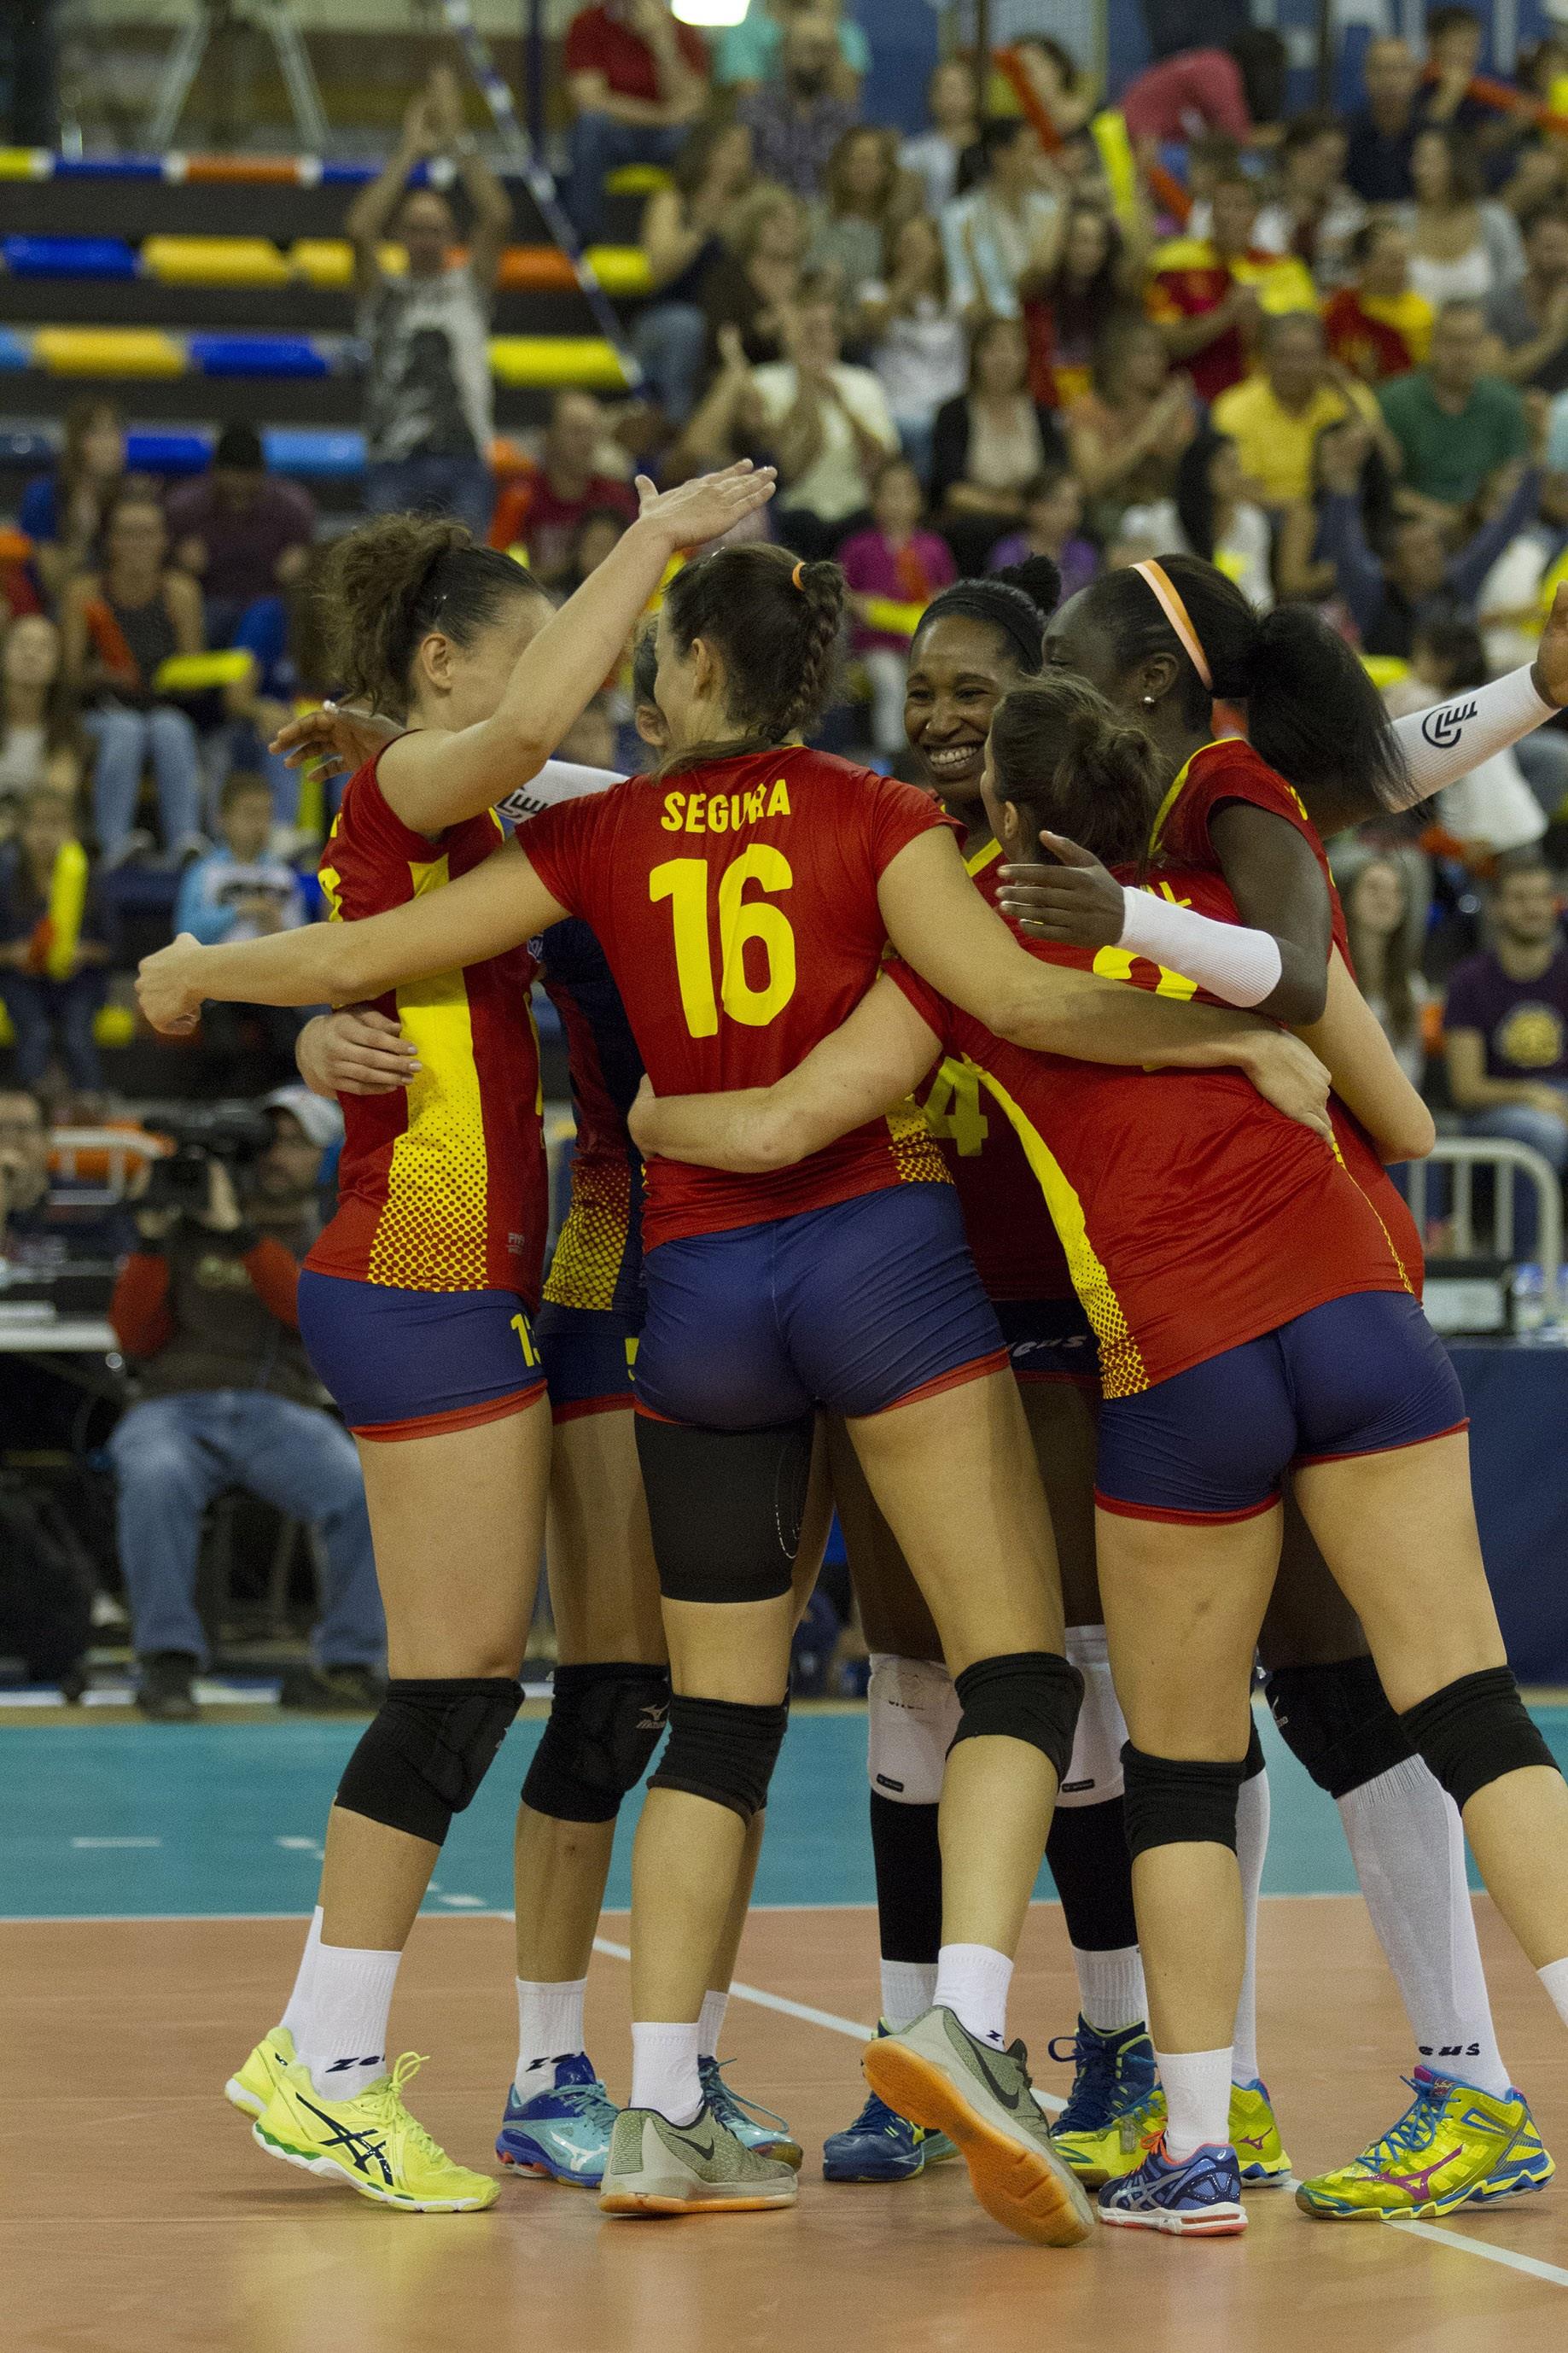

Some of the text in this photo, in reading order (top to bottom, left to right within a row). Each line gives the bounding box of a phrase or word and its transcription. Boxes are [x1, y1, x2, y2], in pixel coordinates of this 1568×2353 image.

[661, 779, 790, 833] SEGURA
[650, 844, 796, 1038] 16
[510, 1313, 541, 1367] 1
